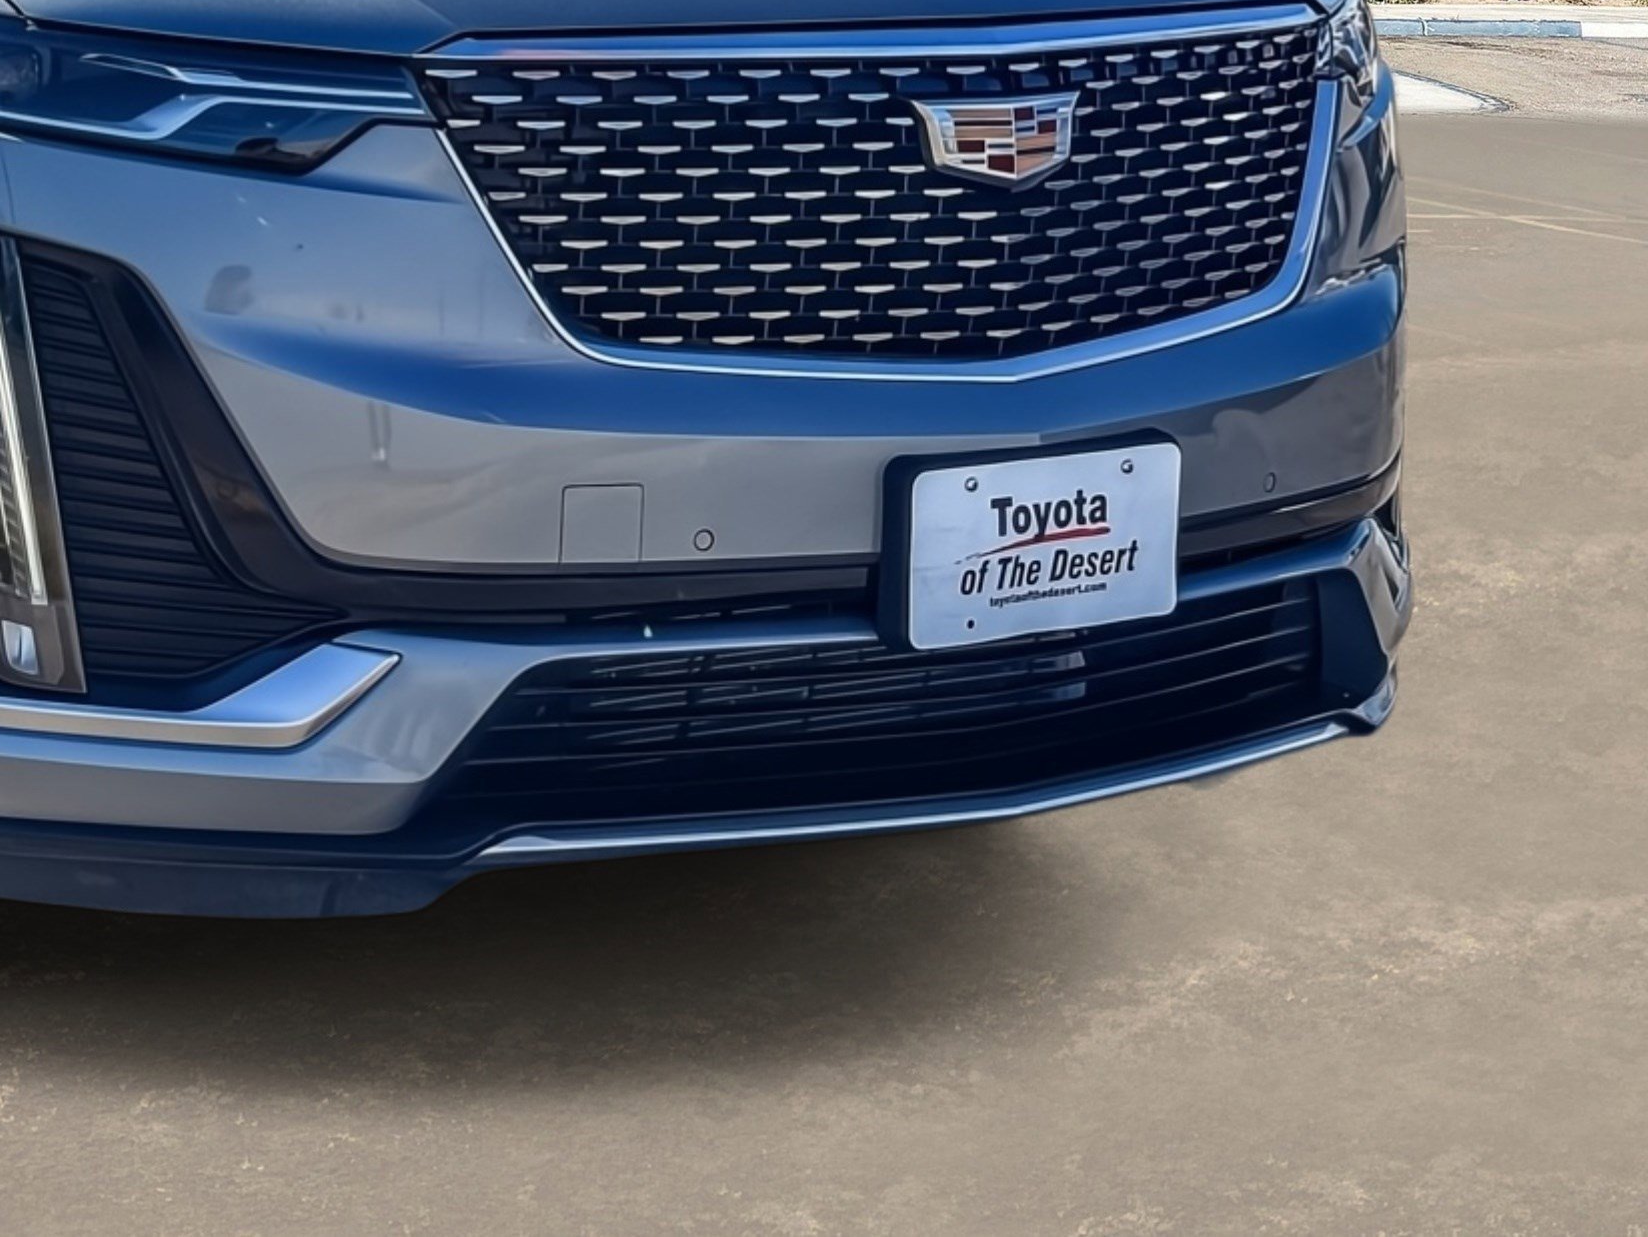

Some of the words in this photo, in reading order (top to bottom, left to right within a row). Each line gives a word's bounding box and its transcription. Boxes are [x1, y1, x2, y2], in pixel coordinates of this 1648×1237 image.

[990, 489, 1108, 540] Toyota
[960, 557, 990, 596] of
[996, 554, 1041, 591] The
[1049, 539, 1139, 583] Desert
[989, 581, 1108, 609] toyotaofthedesert.com
